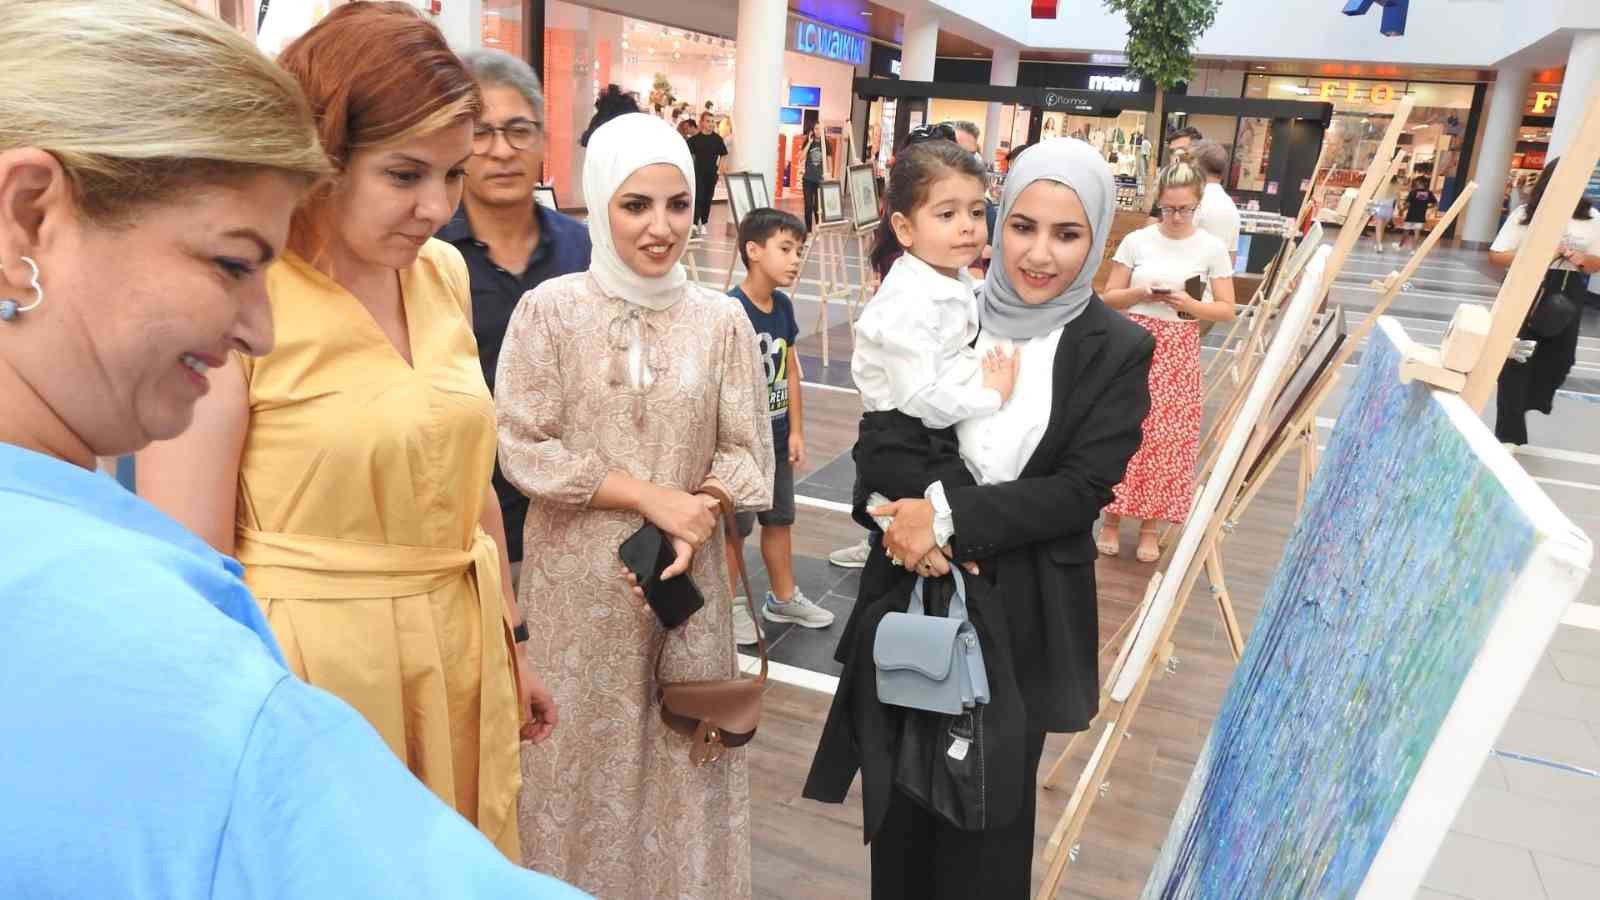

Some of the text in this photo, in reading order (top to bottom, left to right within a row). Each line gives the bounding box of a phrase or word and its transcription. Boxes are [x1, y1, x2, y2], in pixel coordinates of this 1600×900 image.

[798, 22, 817, 52] LC
[1088, 76, 1141, 93] mavi
[1320, 81, 1393, 105] FLO
